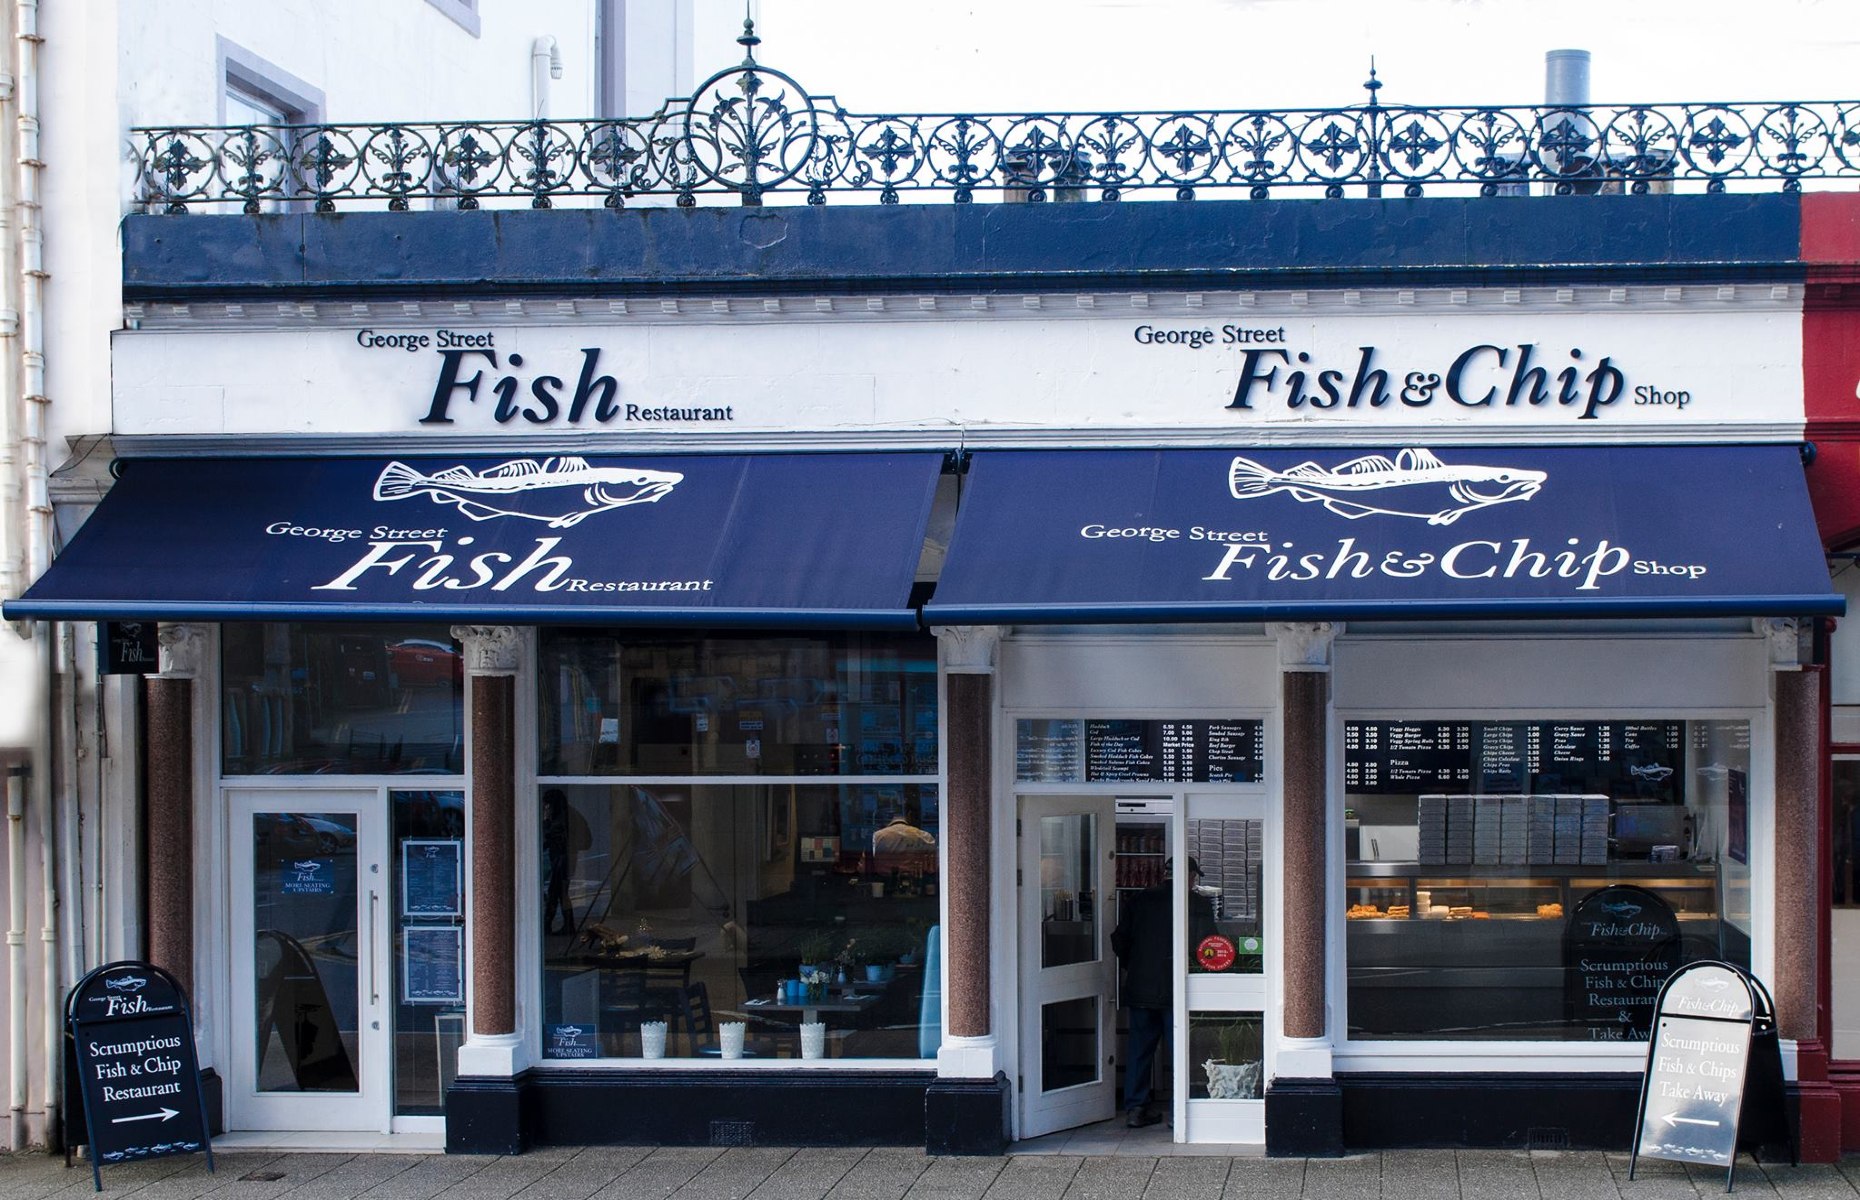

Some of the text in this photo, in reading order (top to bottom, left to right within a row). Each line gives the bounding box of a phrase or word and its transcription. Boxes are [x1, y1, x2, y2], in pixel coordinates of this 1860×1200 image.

[357, 329, 494, 352] George Street
[1133, 325, 1285, 347] George Street
[419, 348, 733, 424] Fish Restaurant
[1224, 344, 1691, 419] Fish & Chip Shop
[265, 522, 448, 542] George Street
[1080, 524, 1268, 542] George Street
[311, 536, 713, 593] Fish Restaurant
[1202, 537, 1707, 589] Fish & Chip Shop
[1591, 923, 1619, 936] Fish
[1628, 922, 1660, 940] Chip
[1580, 958, 1668, 975] Scrumptious
[1585, 976, 1613, 988] Fish
[1617, 980, 1627, 988] &
[106, 995, 148, 1016] Fish
[1589, 993, 1657, 1006] Restauran
[1678, 996, 1701, 1010] Fish
[1710, 999, 1738, 1017] Chip
[1618, 1010, 1632, 1023] &
[1588, 1027, 1624, 1040] Take
[1662, 1032, 1741, 1056] Scrumptious
[89, 1035, 181, 1056] Scrumptious
[95, 1056, 182, 1080] Fish & Chip
[1658, 1056, 1737, 1083] Fish & Chips
[103, 1082, 181, 1102] Restaurant
[1660, 1080, 1728, 1107] Take Away
